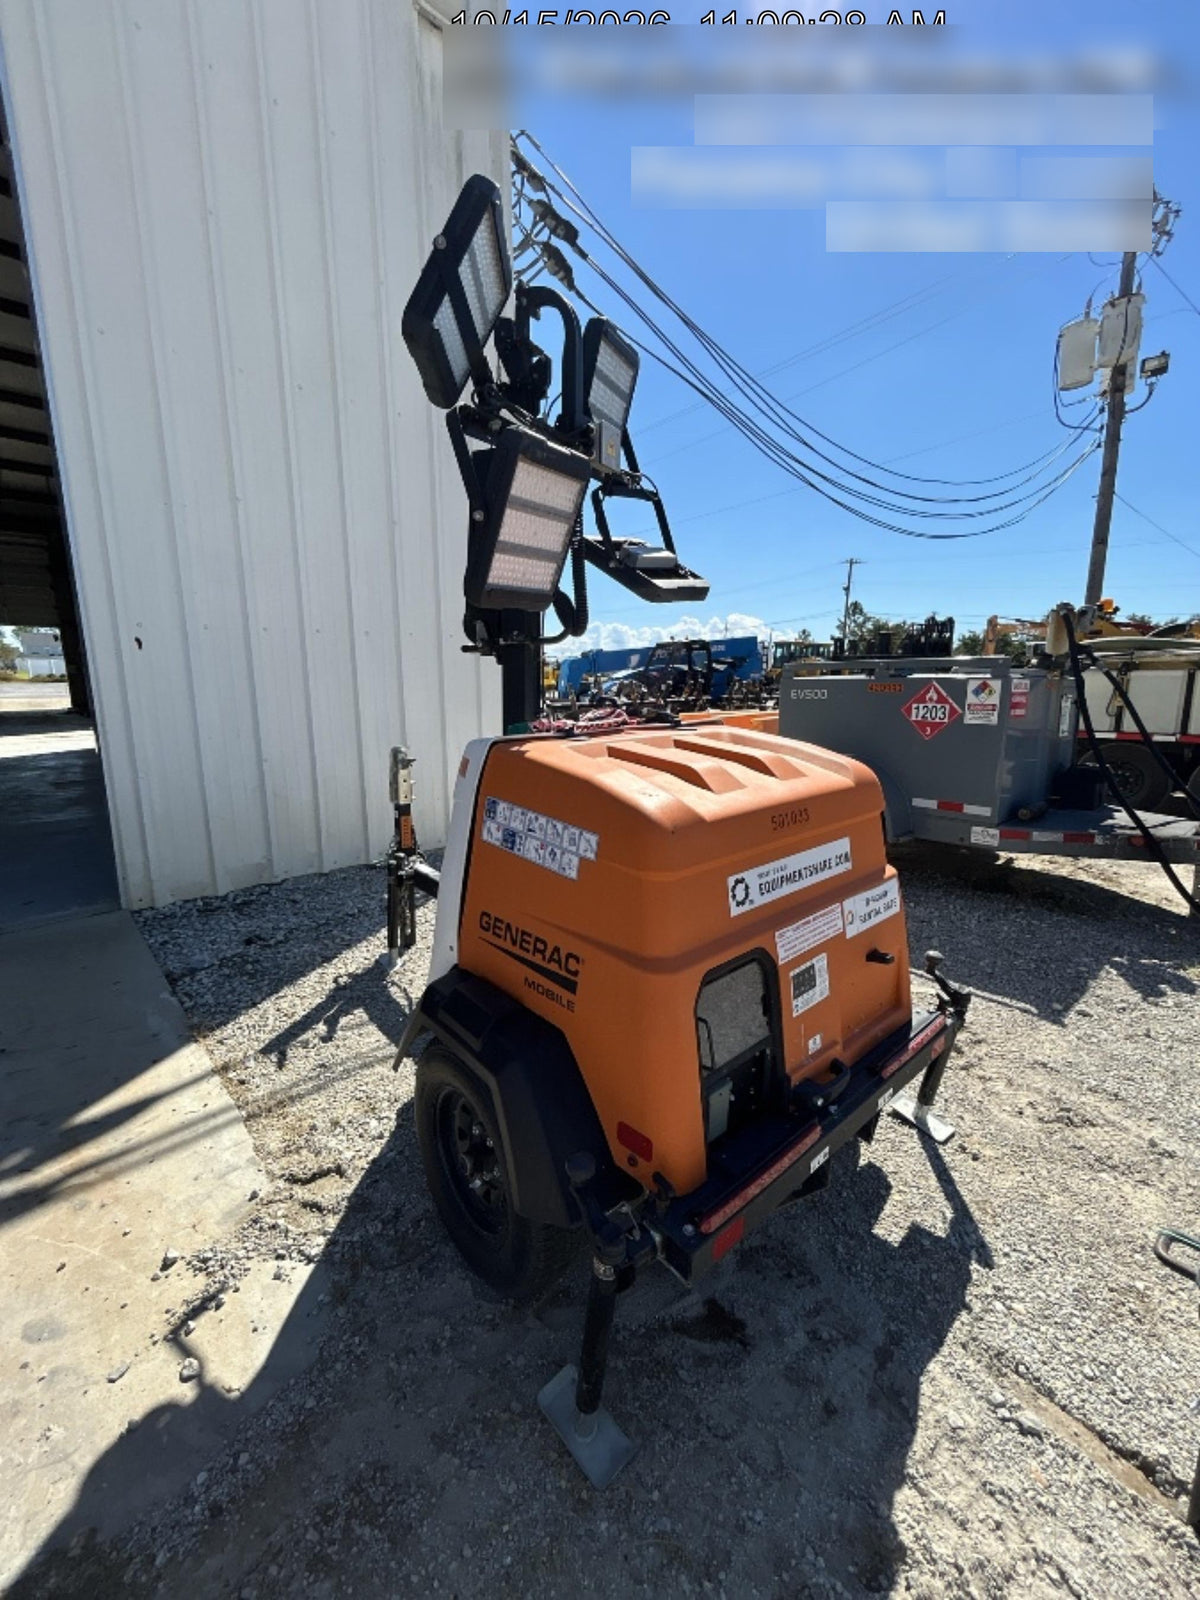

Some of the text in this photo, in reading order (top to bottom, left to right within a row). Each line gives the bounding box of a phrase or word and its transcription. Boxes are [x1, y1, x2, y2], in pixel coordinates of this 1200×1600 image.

[913, 704, 947, 721] 1203
[479, 911, 581, 977] GENERAC
[525, 977, 576, 1012] MOBILE
